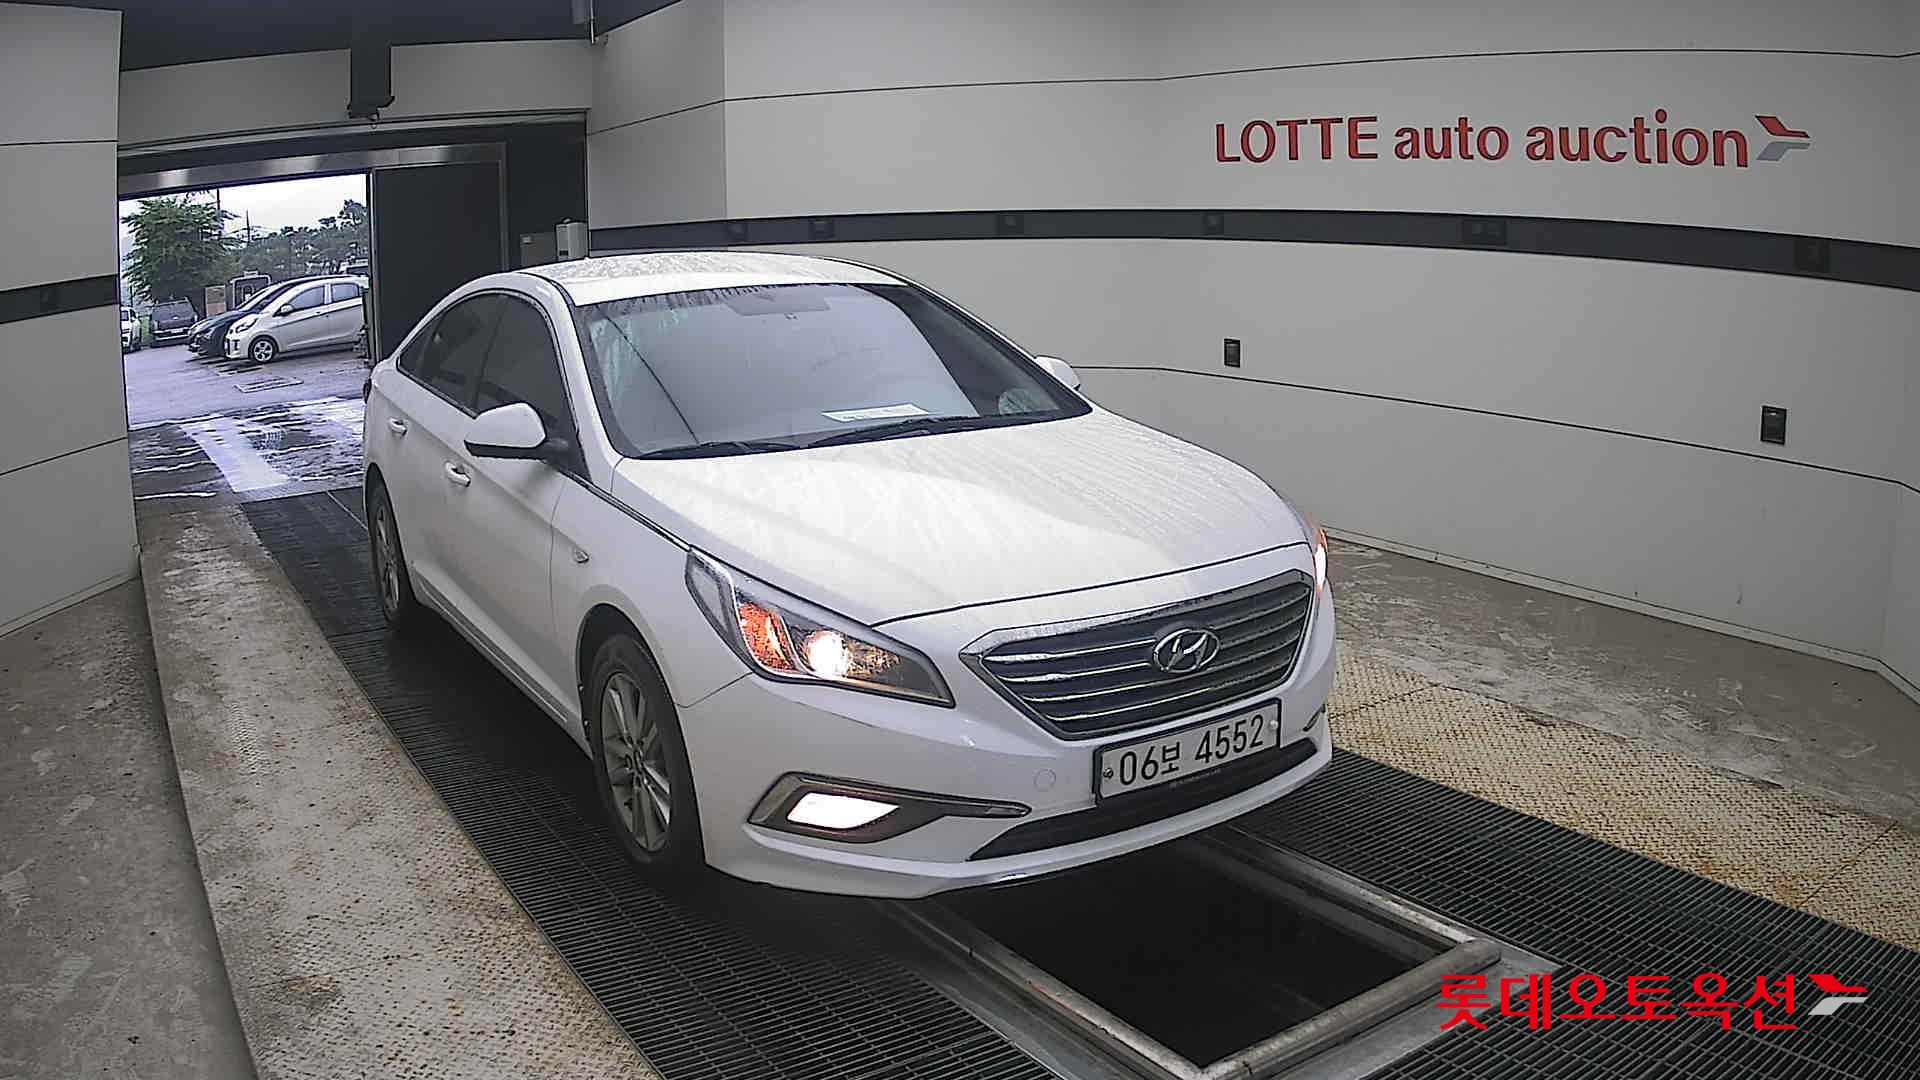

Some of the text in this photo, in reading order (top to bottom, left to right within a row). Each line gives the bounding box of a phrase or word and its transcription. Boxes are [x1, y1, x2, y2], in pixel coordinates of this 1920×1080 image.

[1215, 108, 1750, 168] LOTTE auto auction
[1119, 741, 1181, 786] 06보
[1194, 714, 1264, 764] 4552
